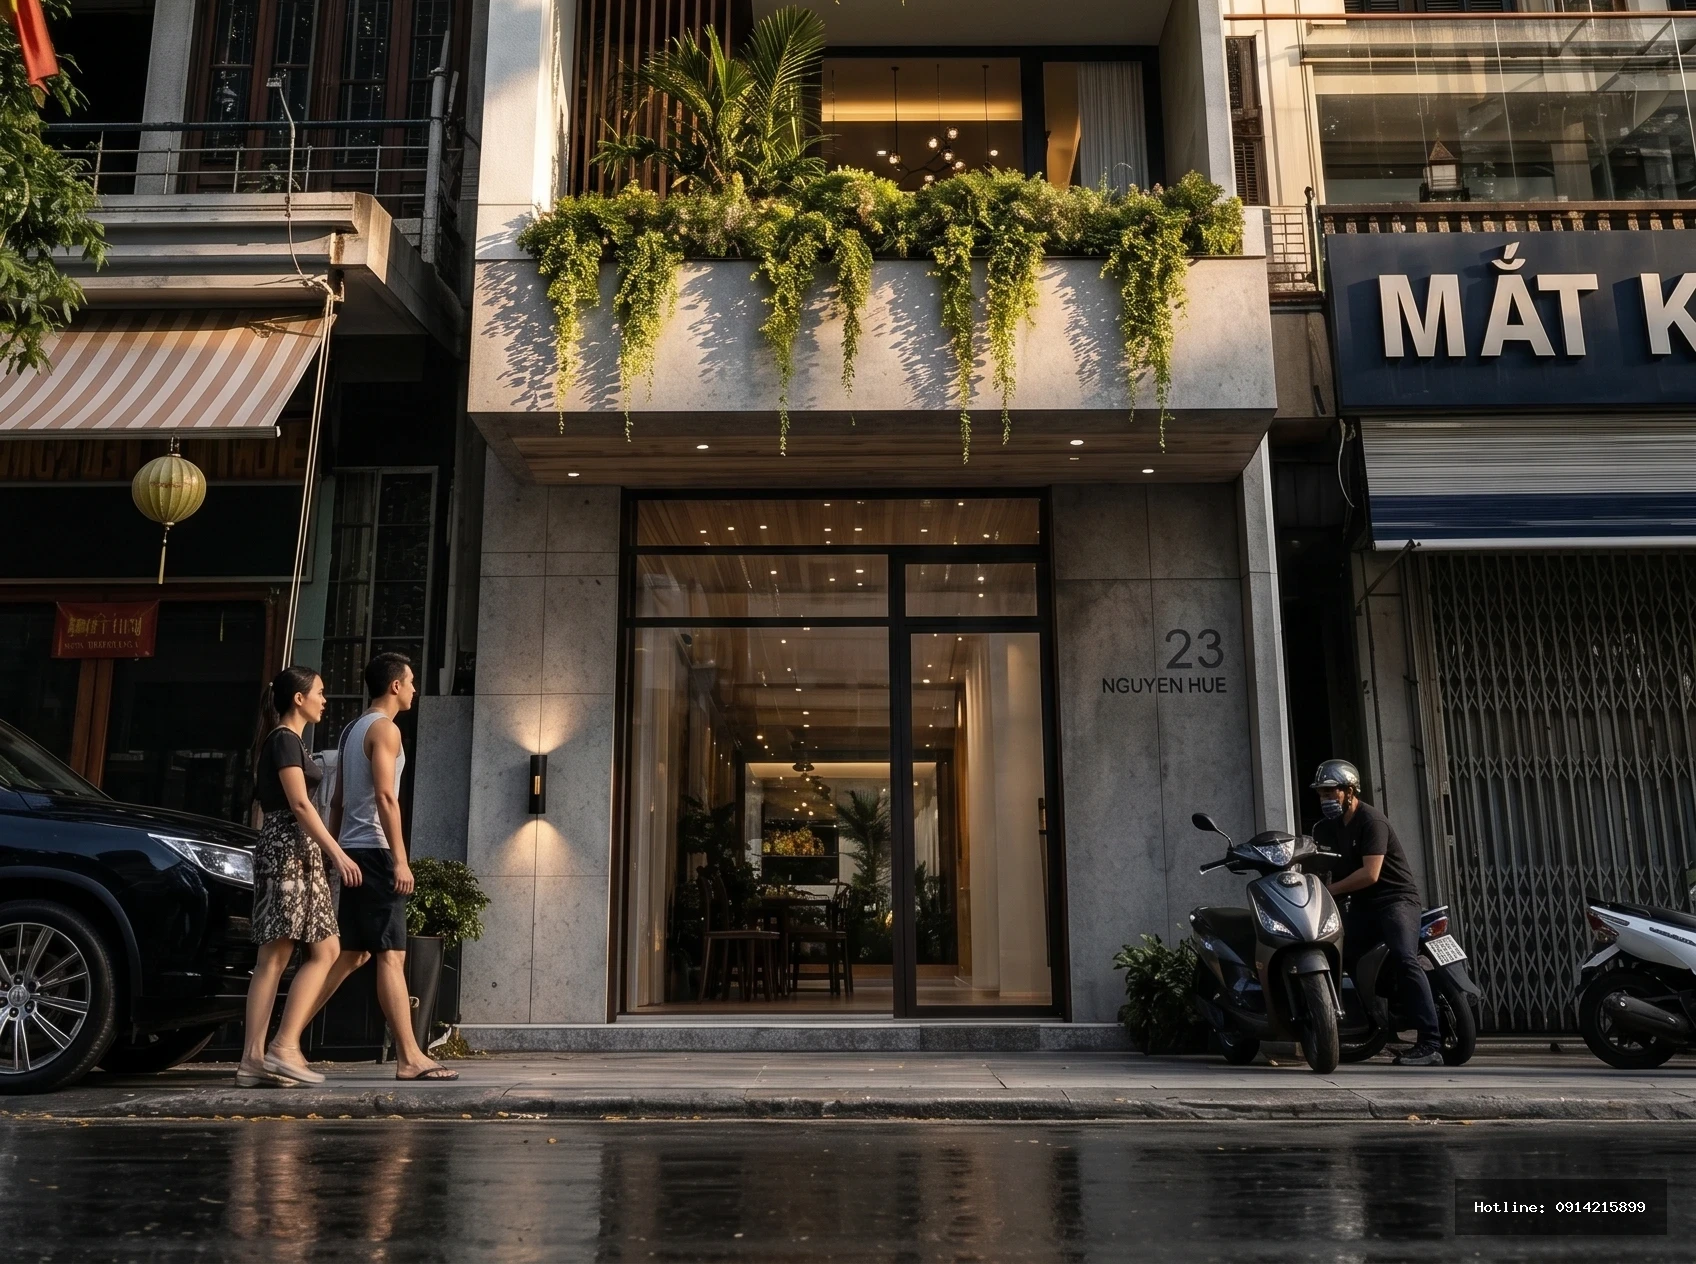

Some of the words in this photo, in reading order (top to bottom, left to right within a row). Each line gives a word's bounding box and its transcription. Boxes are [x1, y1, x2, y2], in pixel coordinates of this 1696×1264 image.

[1379, 241, 1599, 358] MẮT
[1640, 273, 1696, 356] K
[1165, 628, 1225, 669] 23
[1102, 677, 1184, 694] NGUYEN
[1189, 677, 1227, 693] HUE
